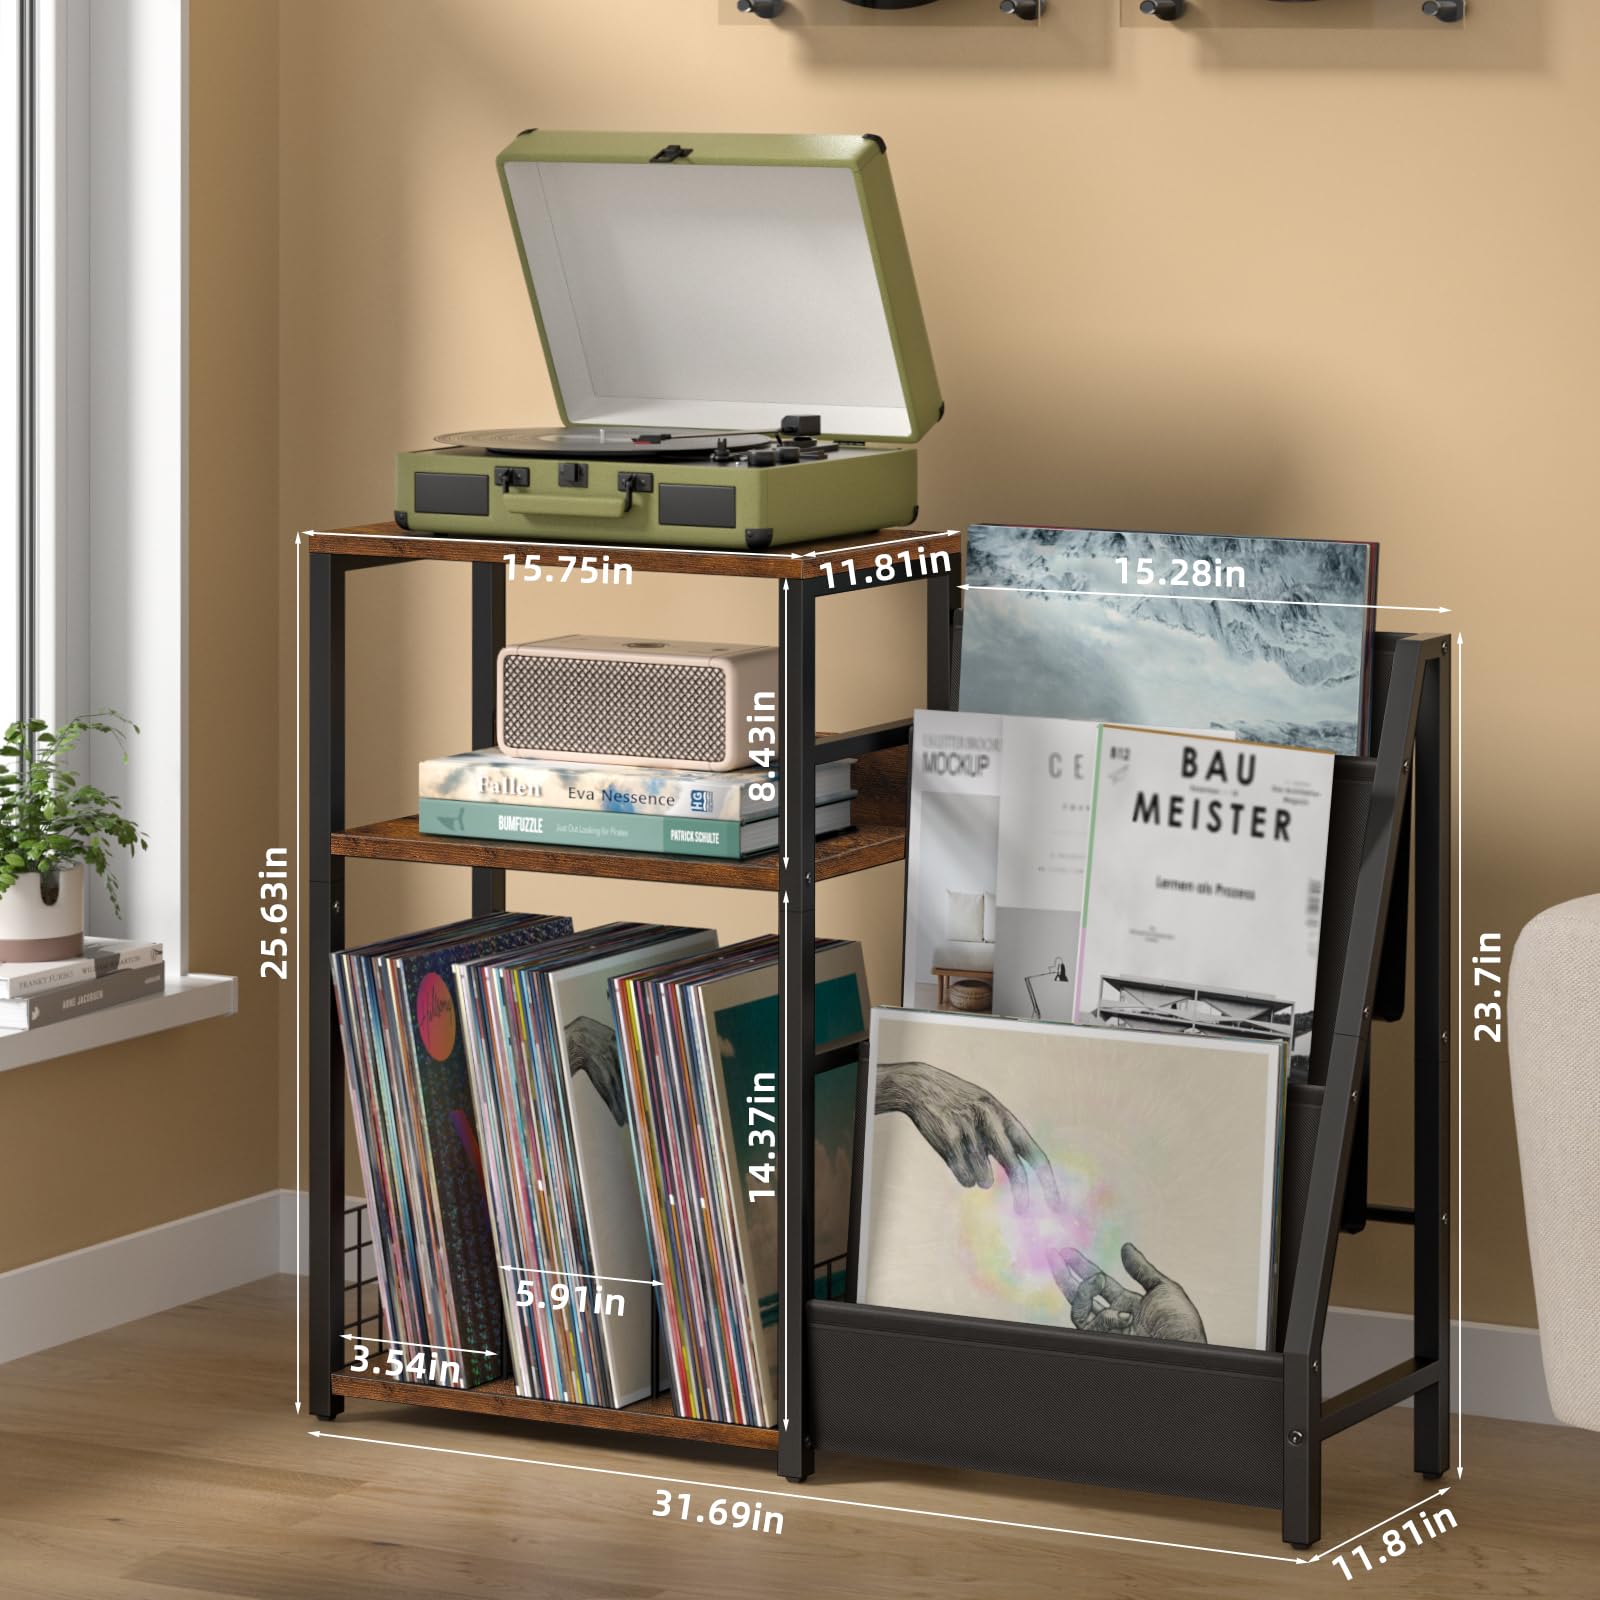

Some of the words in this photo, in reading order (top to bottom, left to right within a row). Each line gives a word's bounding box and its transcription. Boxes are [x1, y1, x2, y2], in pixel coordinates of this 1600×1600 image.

[922, 751, 990, 778] MOCKUP
[1181, 746, 1256, 786] BAU
[478, 775, 544, 798] Fallen
[568, 786, 595, 801] Eva
[601, 788, 676, 807] Nessence
[498, 815, 544, 834] BUMFUZZLE
[1132, 791, 1291, 842] MEISTER
[670, 829, 694, 843] PATRICK
[695, 831, 720, 845] SCHULTE
[1156, 875, 1194, 893] Lernen
[1196, 881, 1212, 895] als
